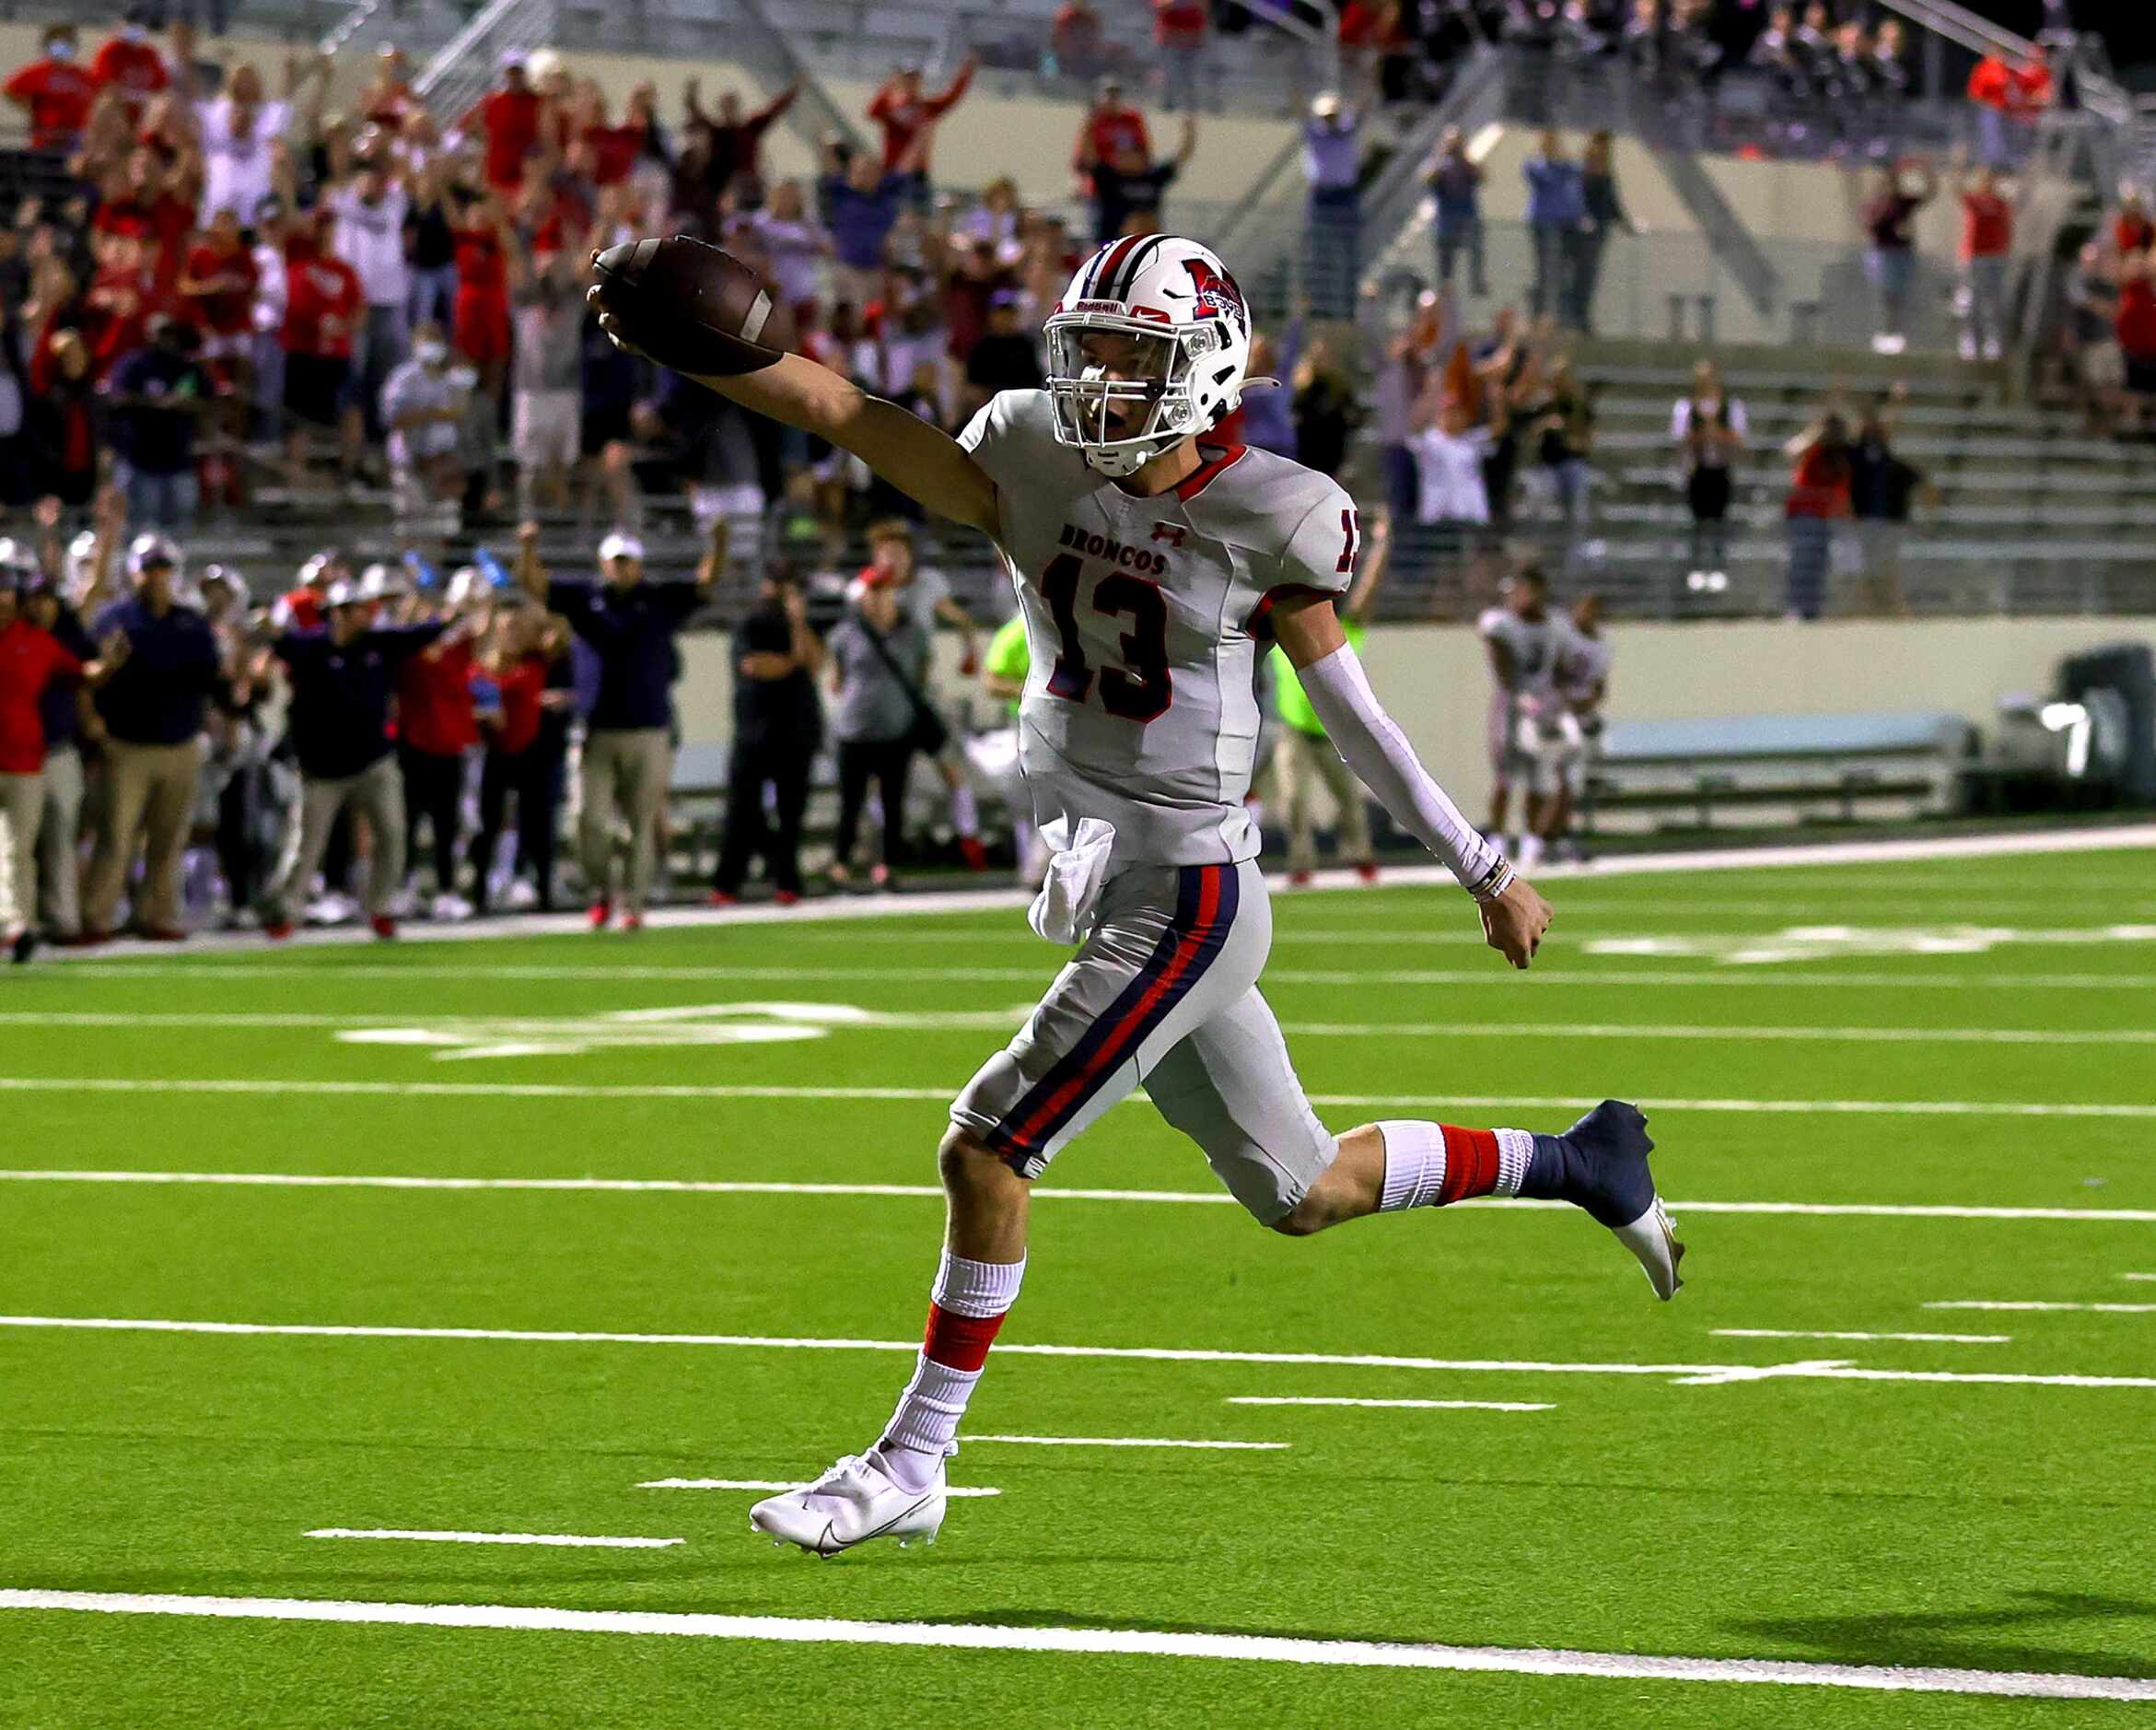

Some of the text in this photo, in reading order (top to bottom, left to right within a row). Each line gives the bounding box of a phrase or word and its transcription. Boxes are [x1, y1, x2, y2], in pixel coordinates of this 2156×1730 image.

[1076, 300, 1119, 312] Riddell
[1059, 523, 1167, 575] BRONCOS
[1335, 508, 1361, 573] 1
[1041, 553, 1172, 724] 13
